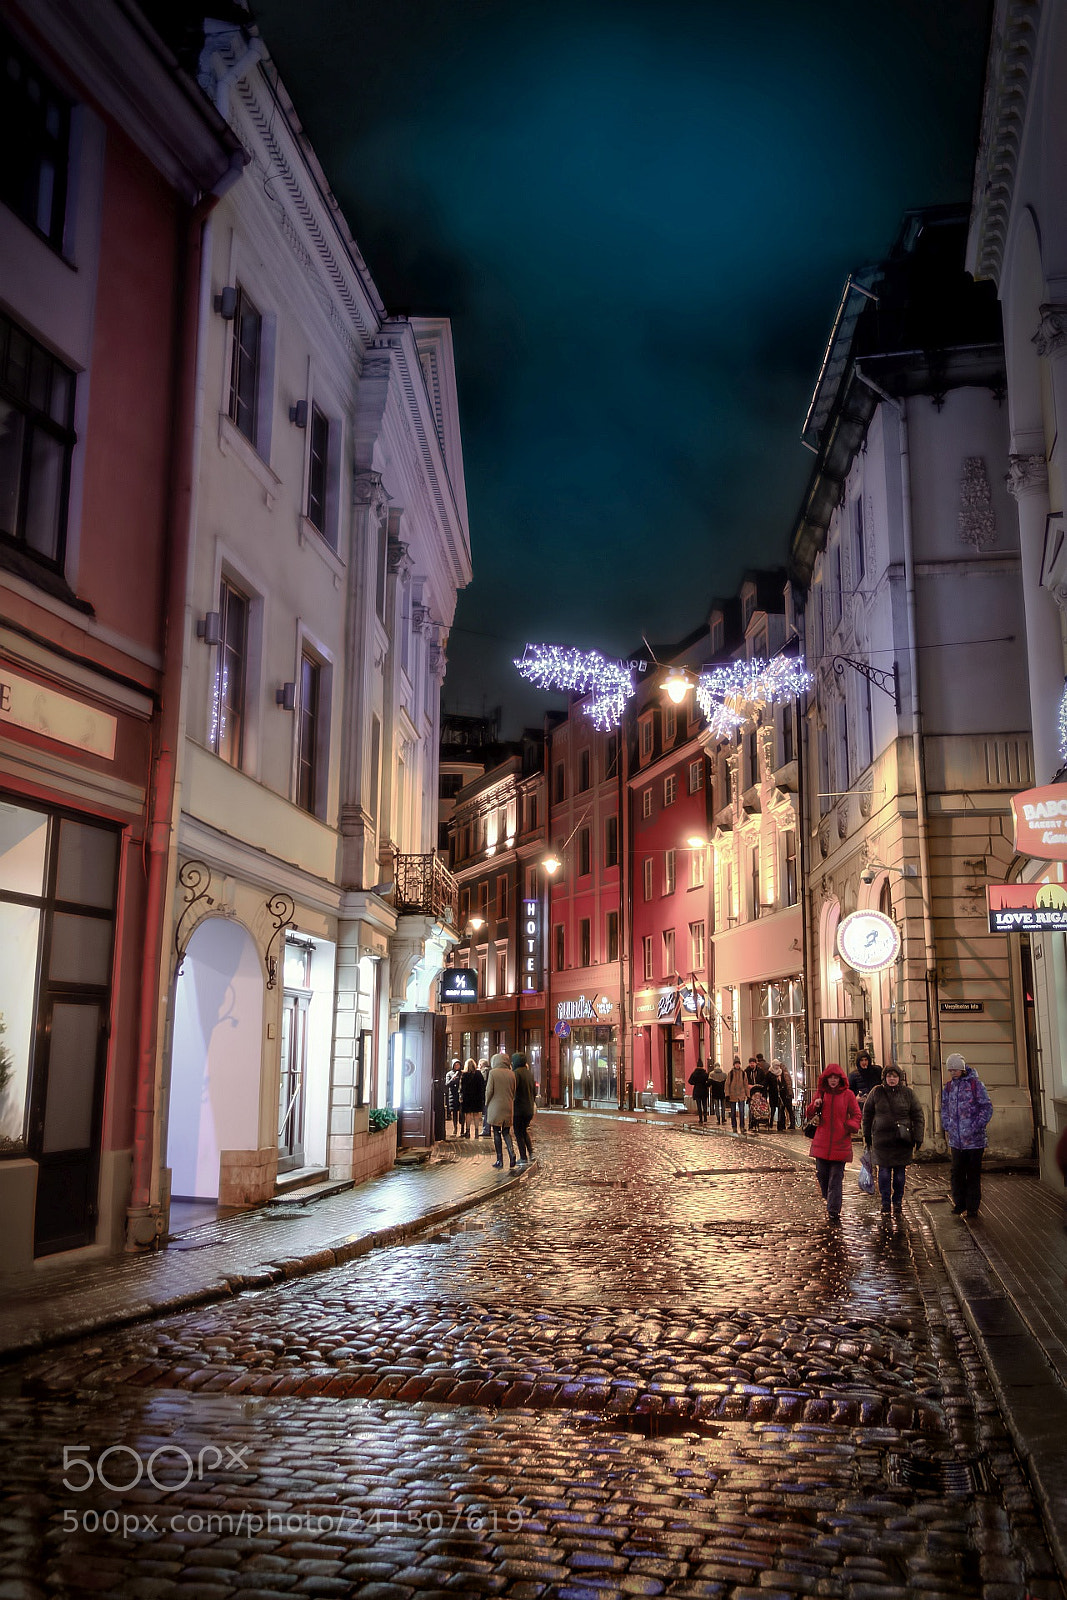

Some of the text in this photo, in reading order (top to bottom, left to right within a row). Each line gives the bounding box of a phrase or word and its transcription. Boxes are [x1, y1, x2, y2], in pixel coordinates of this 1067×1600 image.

[996, 912, 1067, 924] LOVE RIGA
[527, 902, 536, 989] HOTEL
